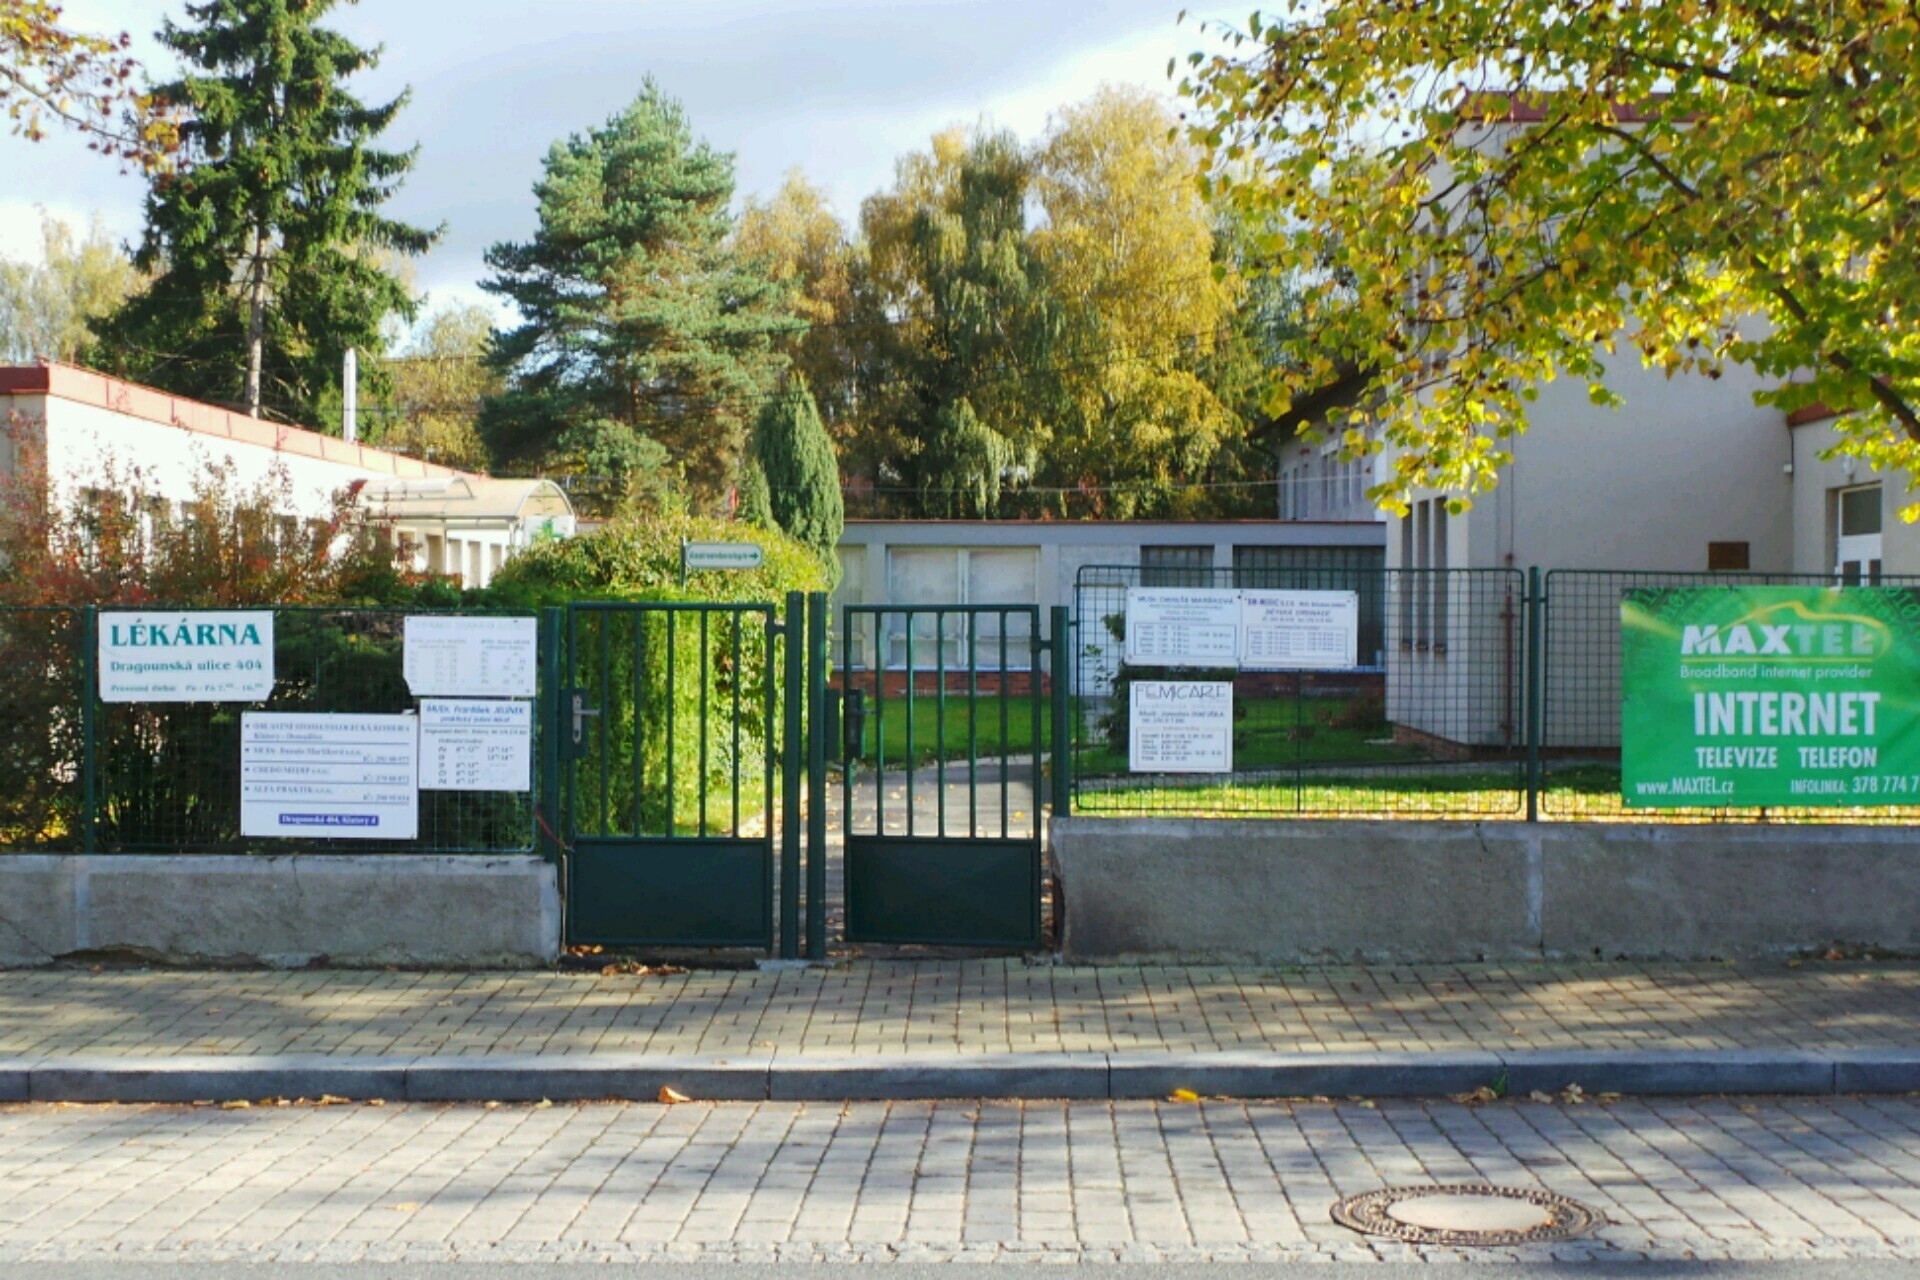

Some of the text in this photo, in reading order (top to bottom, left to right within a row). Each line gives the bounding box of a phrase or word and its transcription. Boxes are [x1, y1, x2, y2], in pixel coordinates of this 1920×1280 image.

[110, 618, 262, 647] LÉKÁRNA
[1680, 624, 1874, 655] MAXTEL
[110, 659, 263, 674] Dragounská ulice 404
[1680, 664, 1873, 681] Broadband internet provider
[1693, 691, 1881, 736] INTERNET
[1695, 746, 1878, 769] TELEVIZE TELEFON
[1636, 776, 1735, 795] www.MAXTEL.cz
[1852, 776, 1878, 793] 378
[1882, 775, 1907, 793] 774
